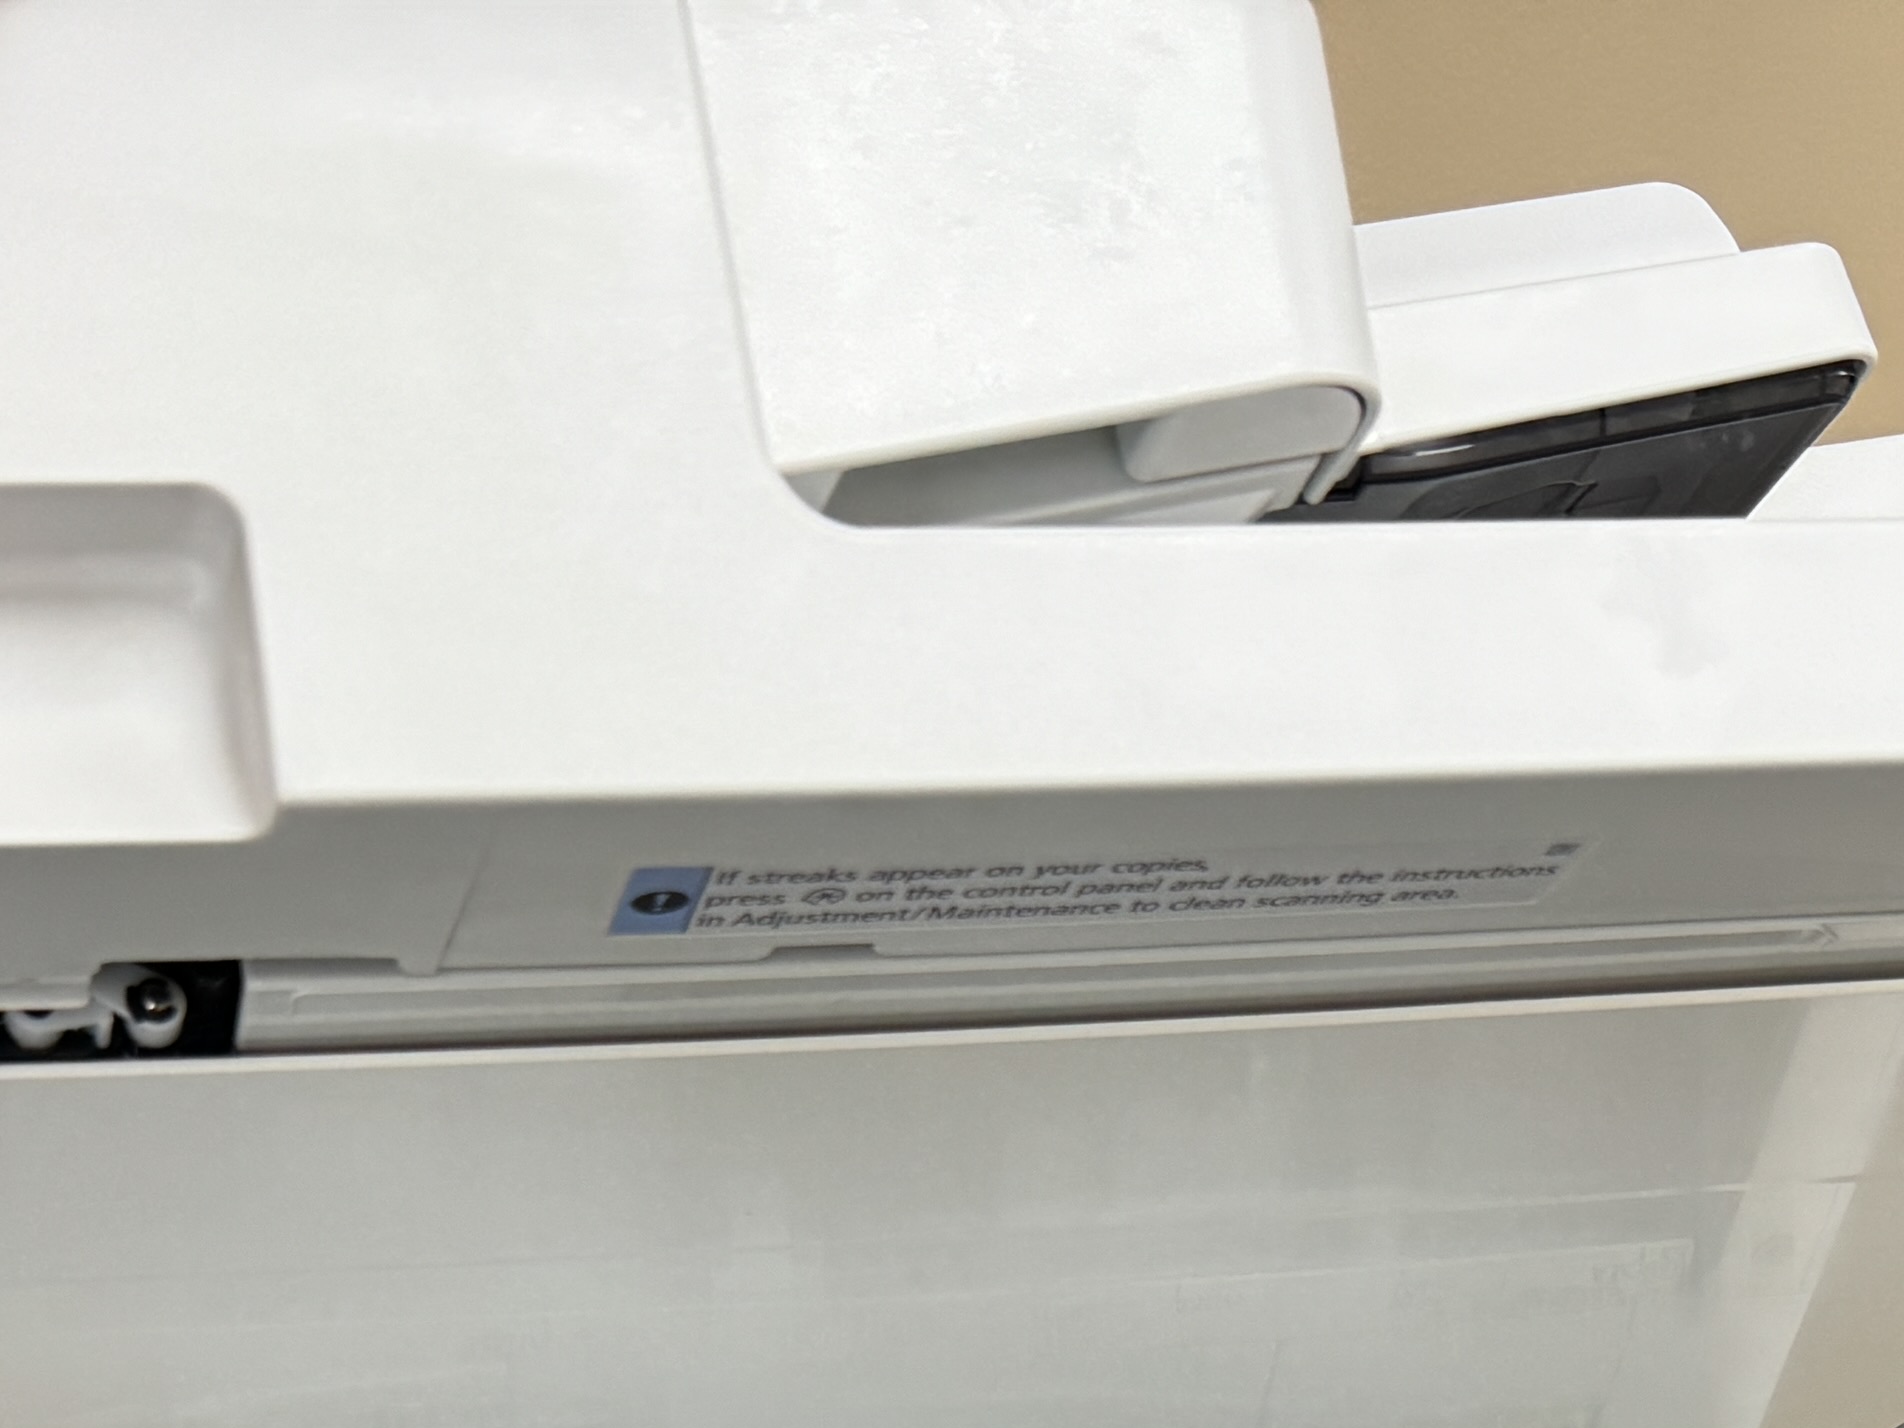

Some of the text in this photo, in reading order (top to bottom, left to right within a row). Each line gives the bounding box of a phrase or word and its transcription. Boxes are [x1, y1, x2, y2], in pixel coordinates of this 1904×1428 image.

[703, 866, 1559, 910] press on the control panel and follow the instructions
[716, 869, 742, 886] If
[748, 868, 858, 885] streaks
[866, 867, 977, 885] appear
[984, 866, 1025, 878] on
[1032, 863, 1103, 880] your
[696, 913, 726, 928] in
[730, 903, 1122, 930] Adjustment/Maintenance
[1128, 899, 1161, 915] to
[1168, 896, 1247, 912] clean
[1252, 890, 1387, 908] scanning
